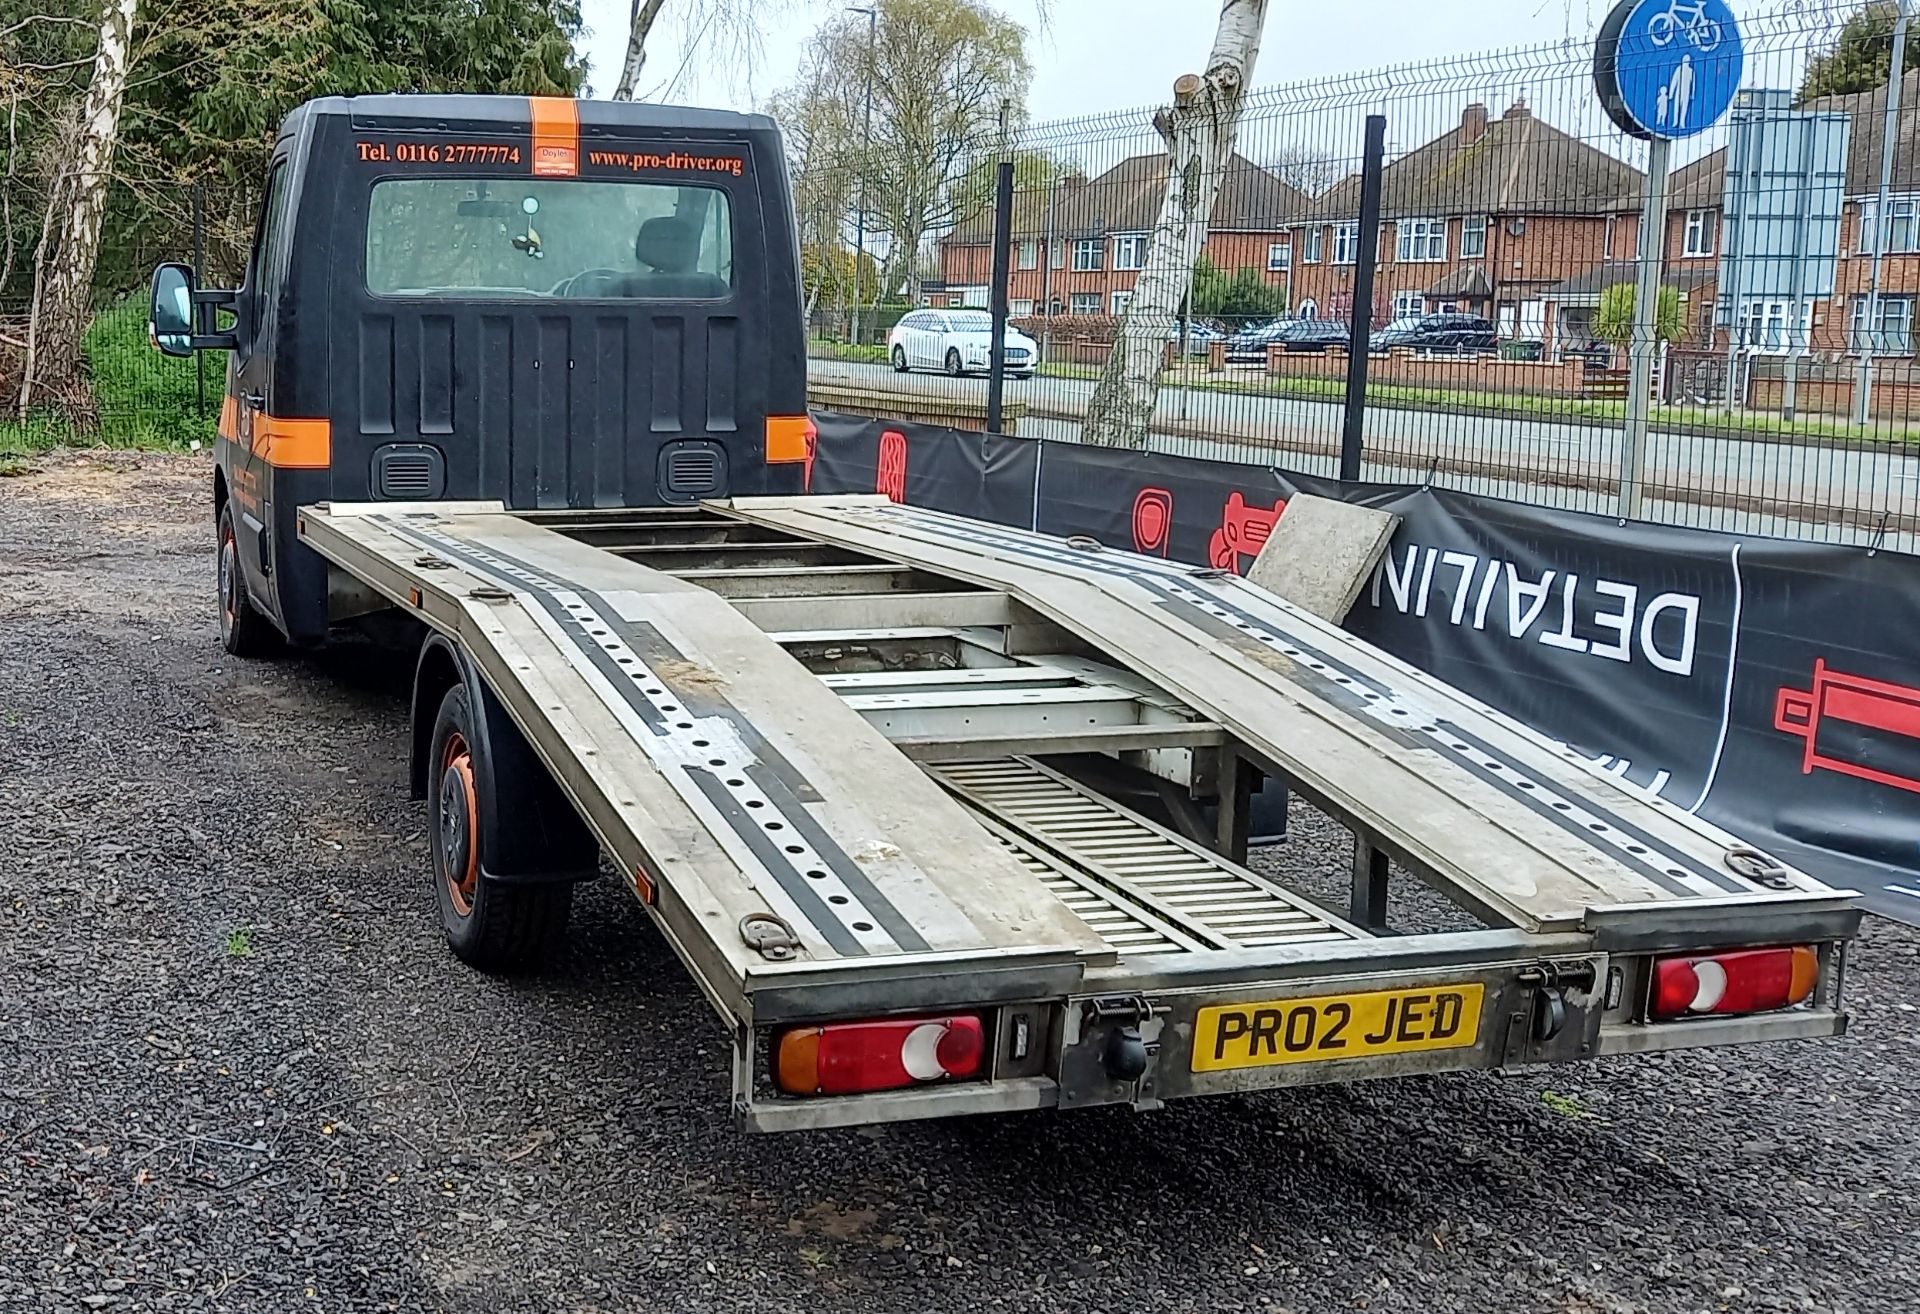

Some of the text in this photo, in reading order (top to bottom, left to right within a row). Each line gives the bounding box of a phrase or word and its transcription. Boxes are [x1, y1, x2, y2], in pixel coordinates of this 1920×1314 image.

[356, 143, 521, 164] Tel. 0116 2777774
[588, 151, 742, 176] www.pro-driver.org
[1214, 993, 1464, 1060] PR02 JED
